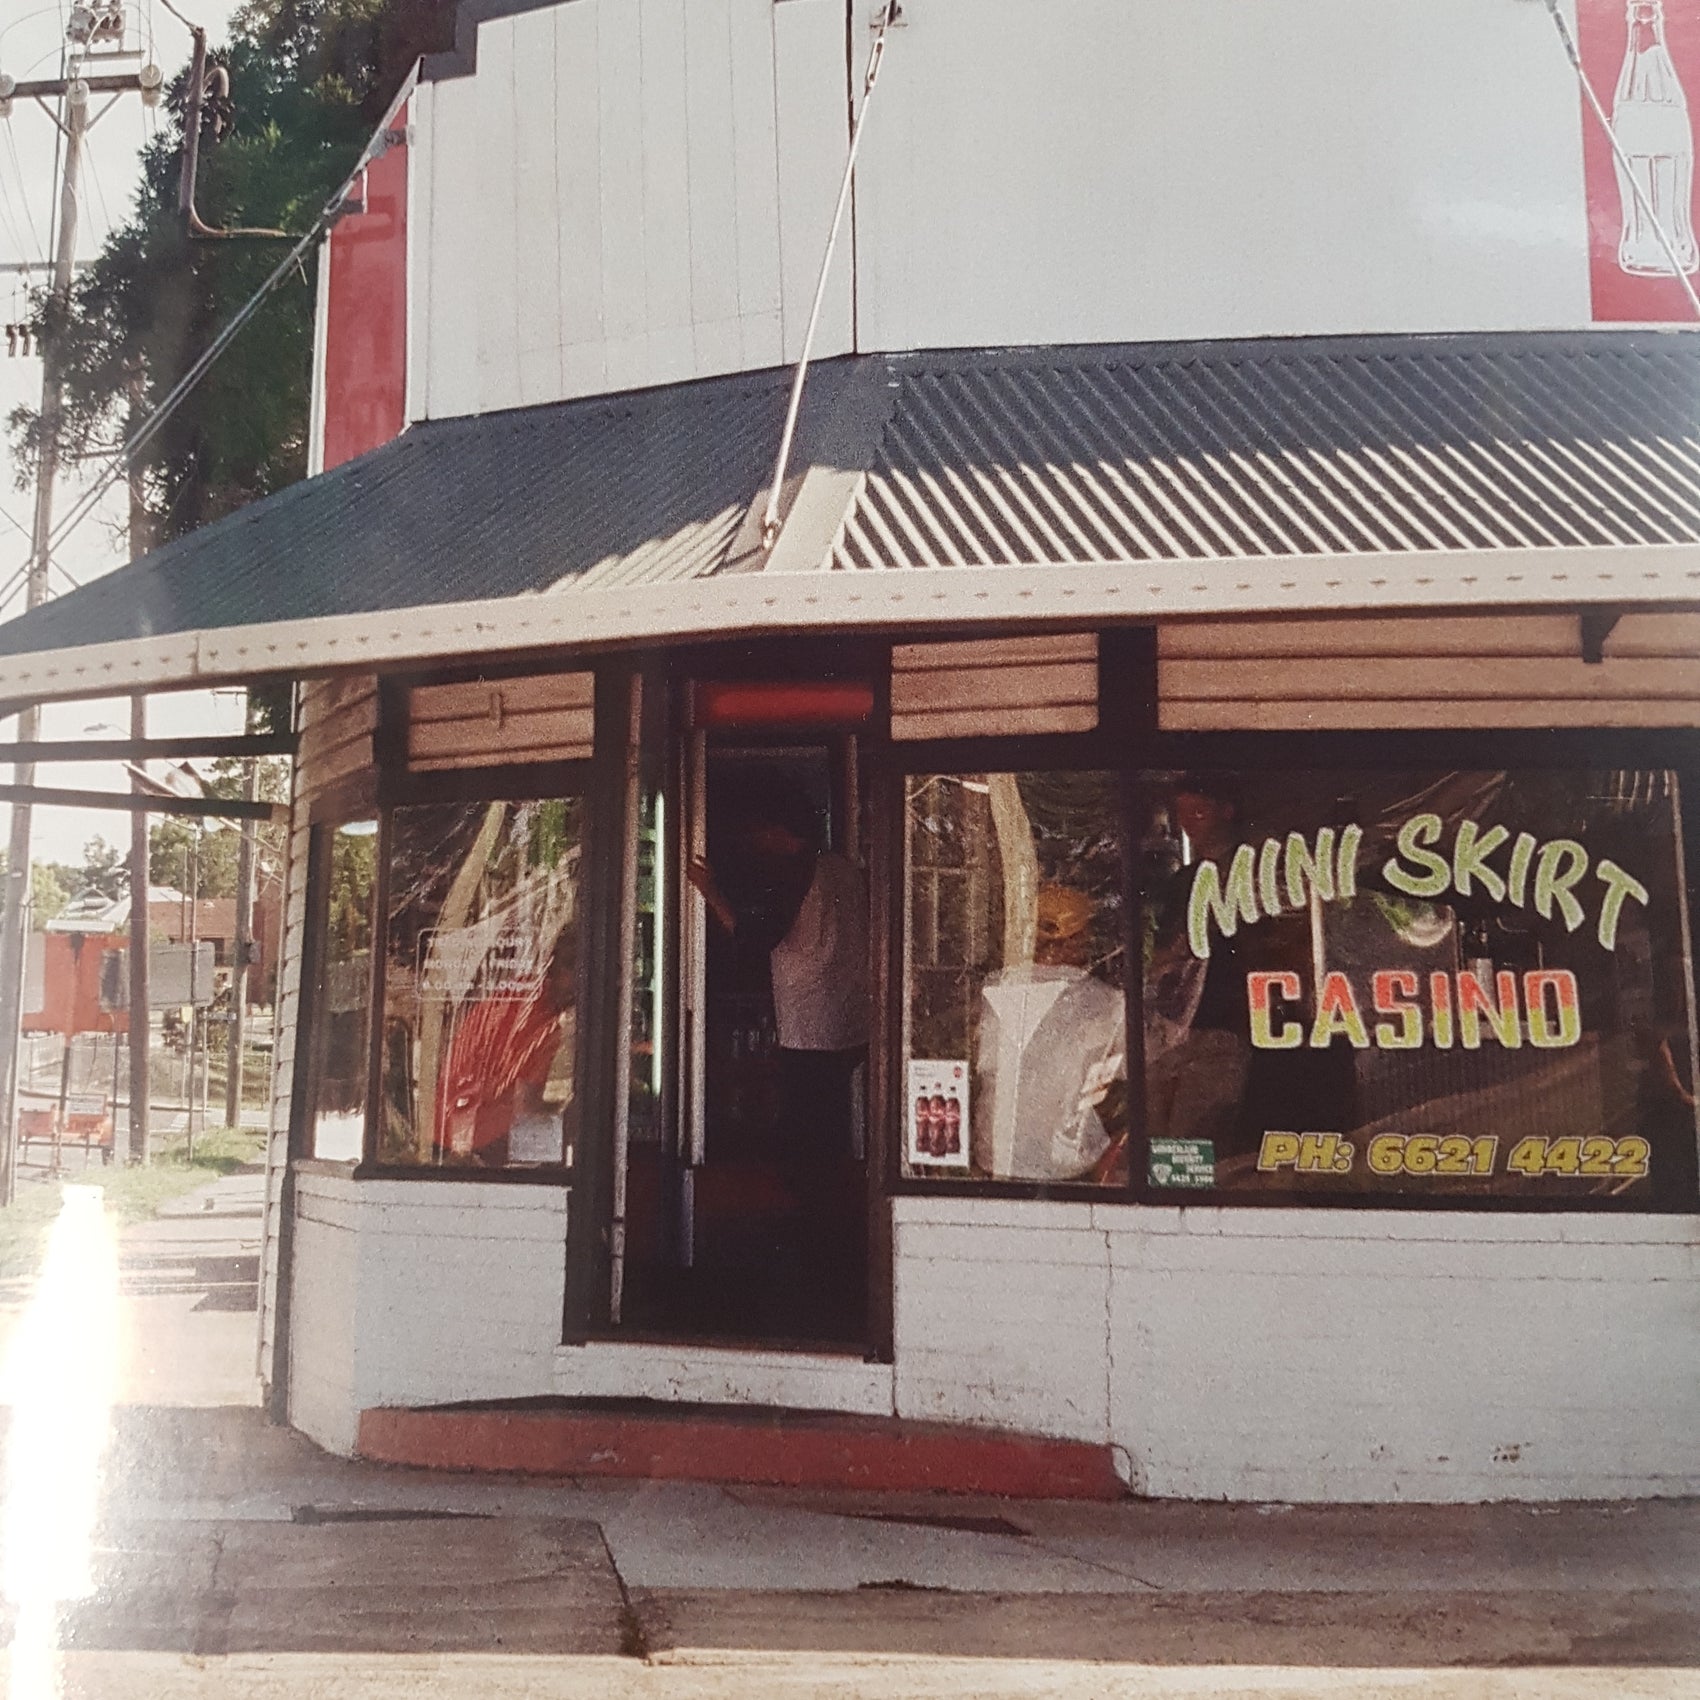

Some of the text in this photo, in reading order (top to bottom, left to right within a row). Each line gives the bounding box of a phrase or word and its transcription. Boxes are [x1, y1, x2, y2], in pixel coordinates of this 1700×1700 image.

[1187, 813, 1650, 959] MINI SKIRT
[1246, 968, 1582, 1049] CASINO
[1256, 1130, 1650, 1176] PH: 6621 4422
